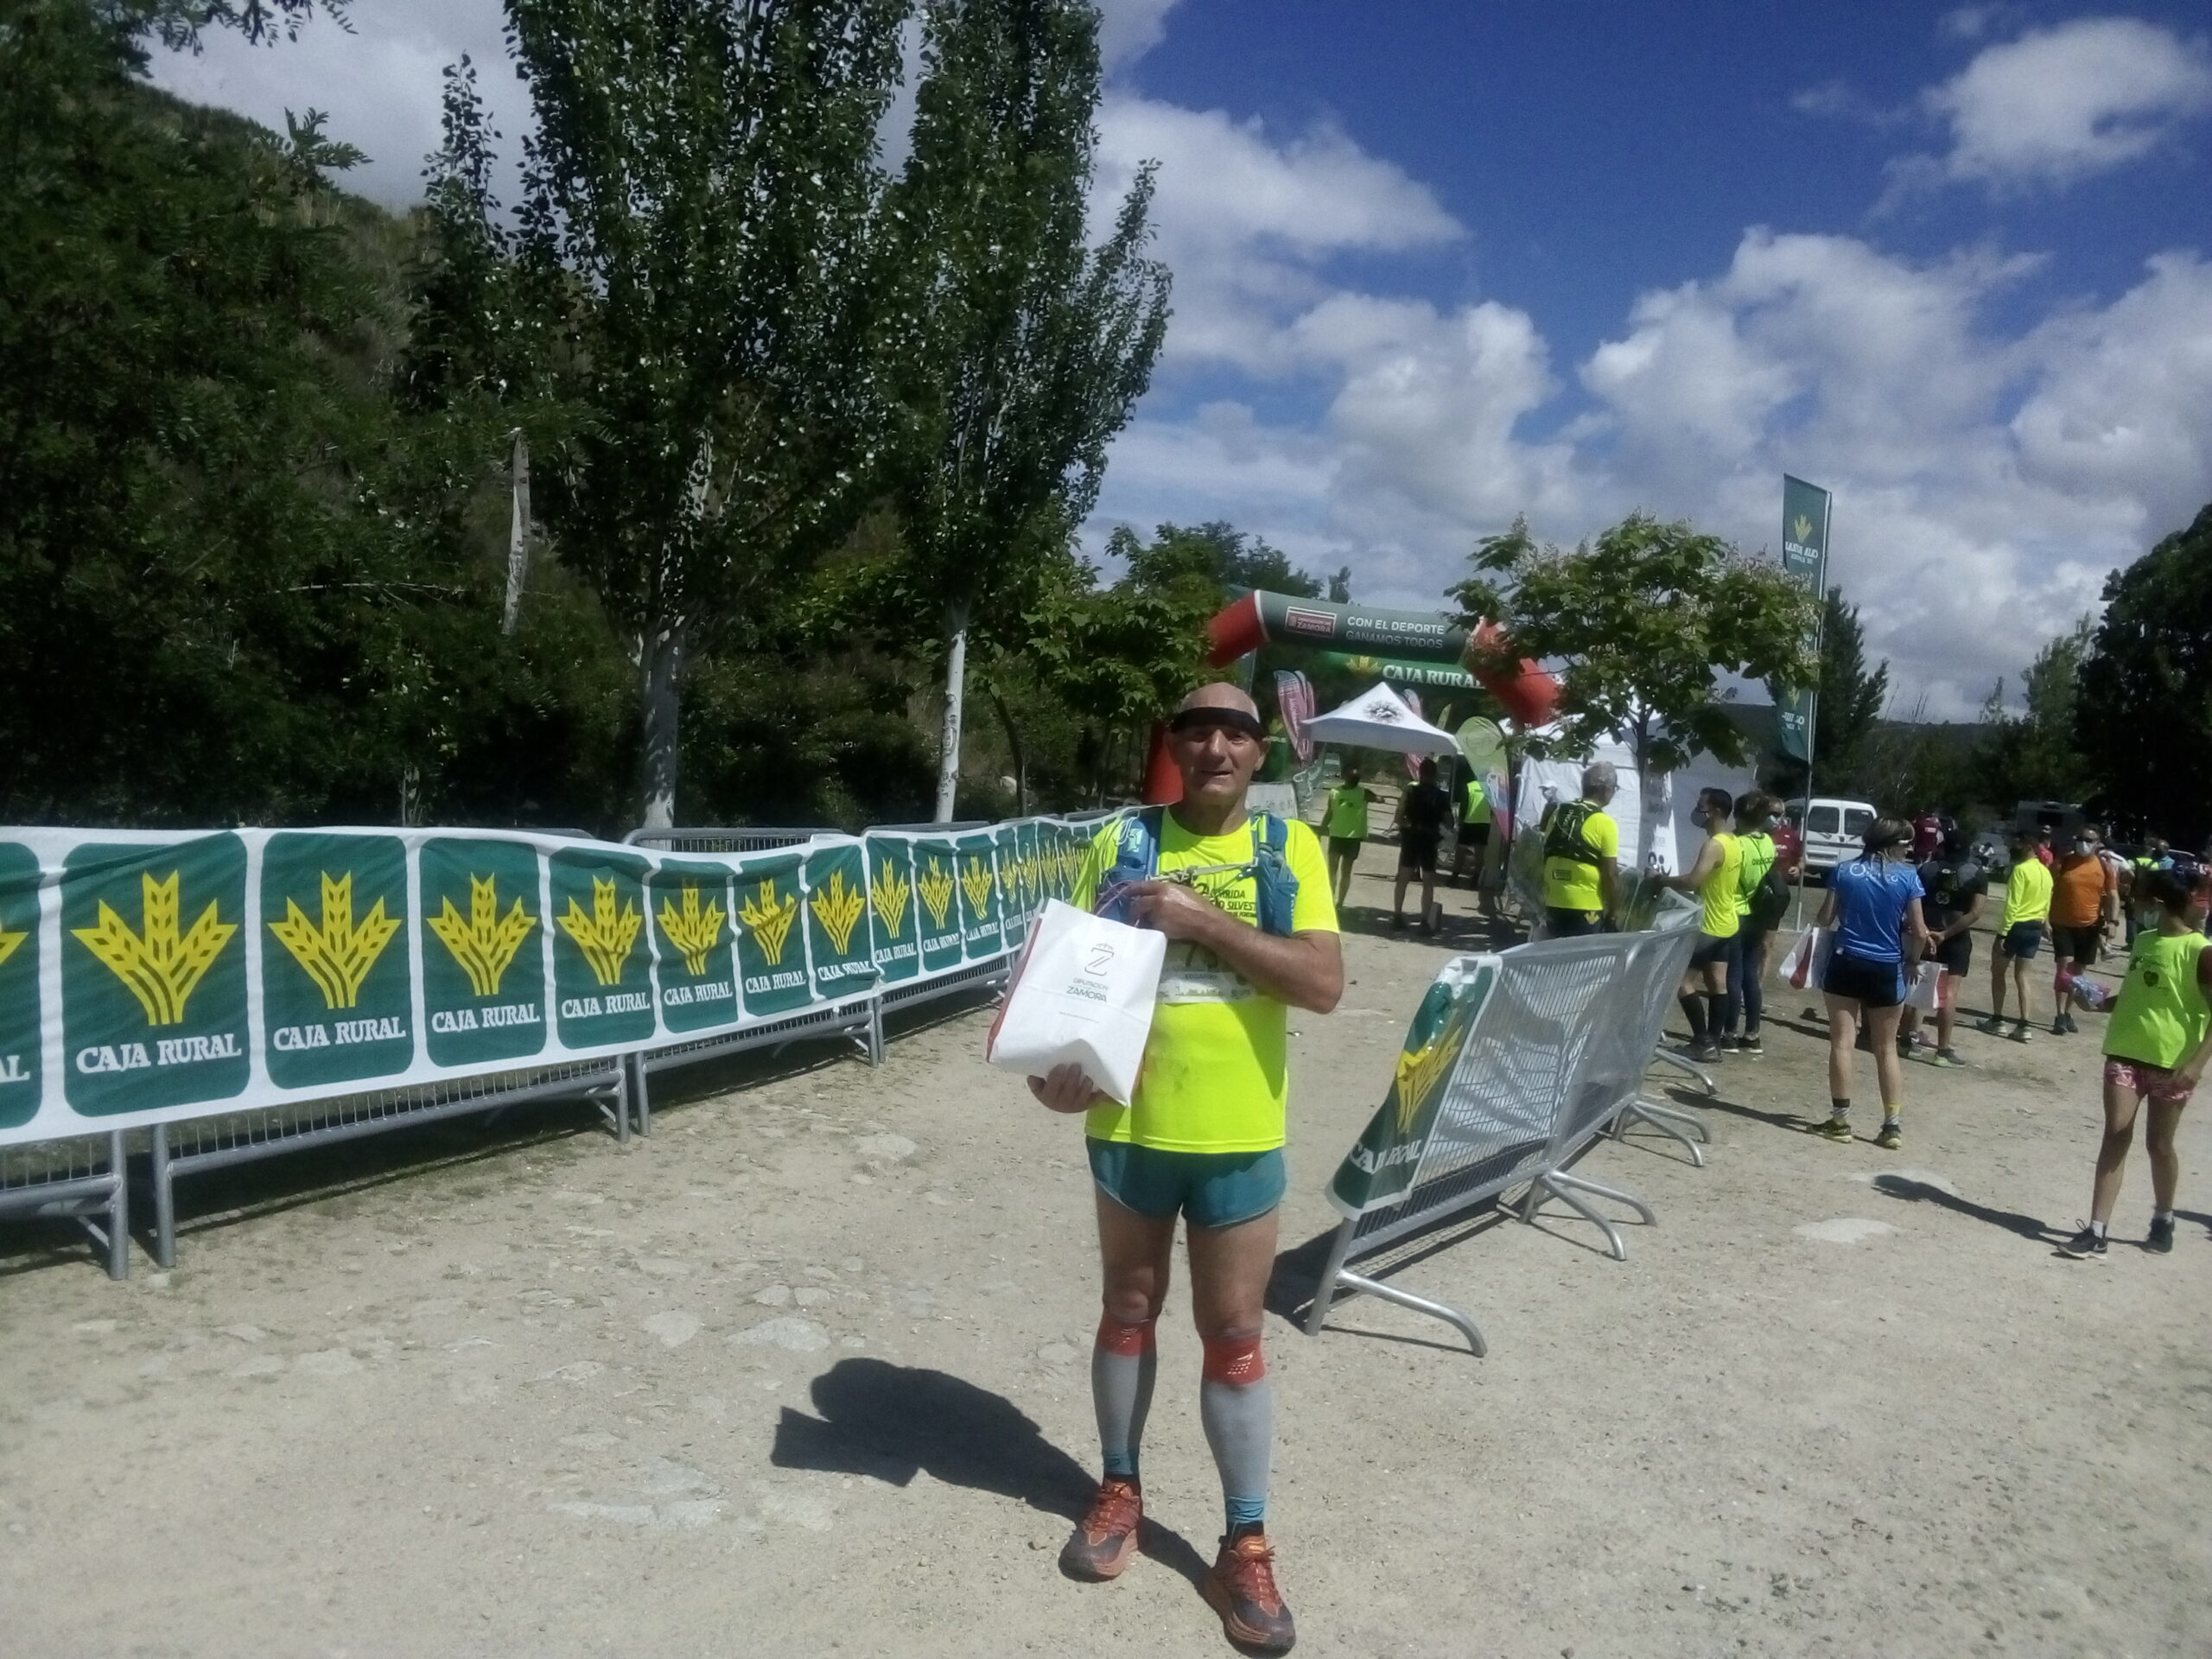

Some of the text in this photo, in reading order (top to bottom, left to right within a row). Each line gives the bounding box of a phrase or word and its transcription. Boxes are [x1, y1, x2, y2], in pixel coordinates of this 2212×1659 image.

[1297, 621, 1331, 632] ZAMORA
[1347, 616, 1445, 635] CON EL DEPORTE
[1345, 630, 1444, 649] GANAMOS TODOS
[1383, 664, 1423, 682] CAJA
[874, 943, 918, 963] CAJA RURAL
[817, 963, 843, 981] CAJA
[746, 970, 806, 995] CAJA RURAL
[664, 982, 733, 1006] CAJA RURAL
[1066, 986, 1107, 1002] ZAMORA
[561, 992, 651, 1019] CAJA RURAL
[432, 1003, 541, 1033] CAJA RURAL
[273, 1016, 406, 1052] CAJA RURAL
[76, 1033, 242, 1074] CAJA RURAL
